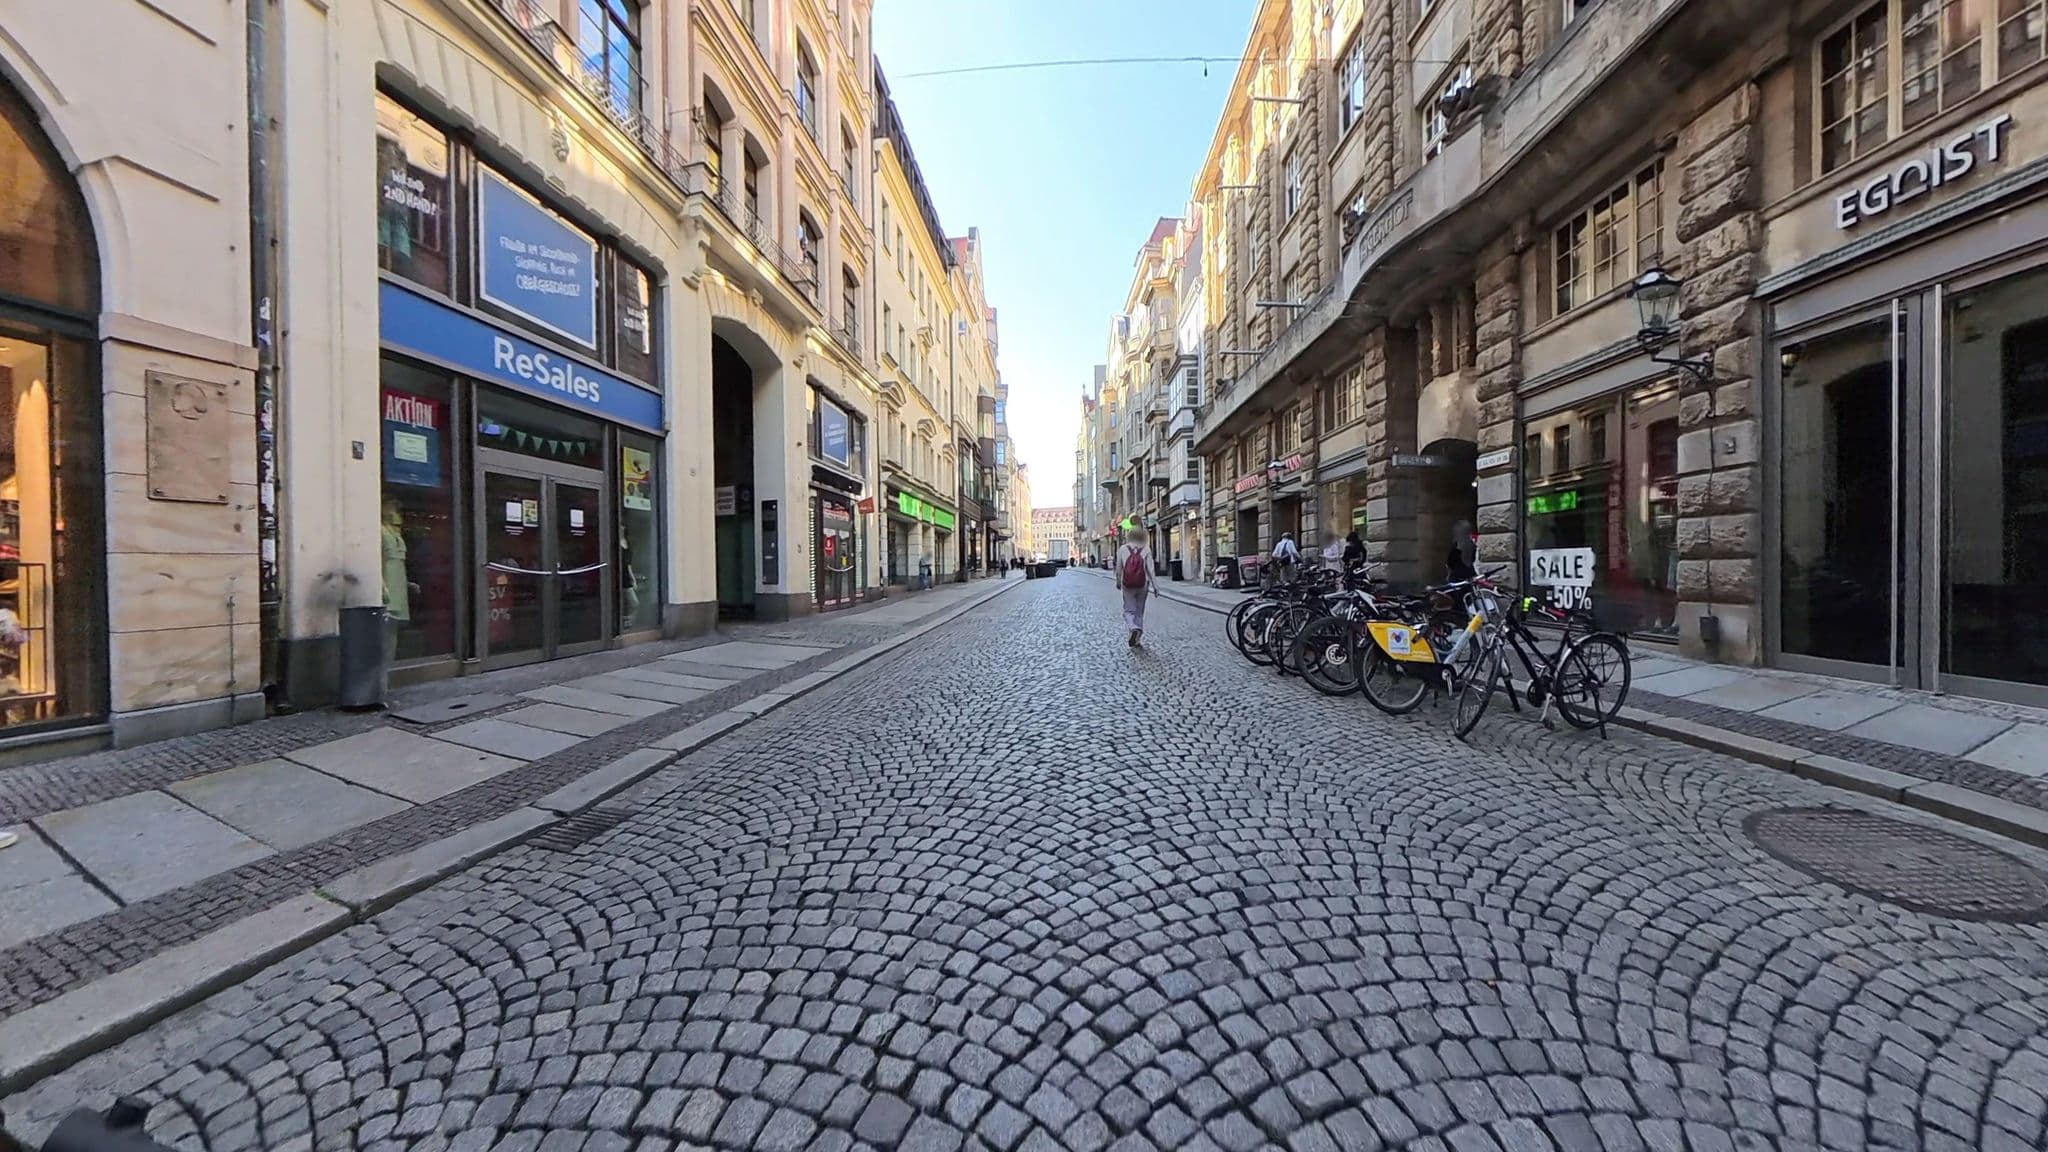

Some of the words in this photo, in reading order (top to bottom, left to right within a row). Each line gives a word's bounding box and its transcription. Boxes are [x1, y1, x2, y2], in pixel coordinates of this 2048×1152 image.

[1836, 113, 2011, 230] EGOIST
[494, 335, 600, 403] ReSales
[1536, 555, 1584, 579] SALE
[1546, 586, 1592, 610] -50%
